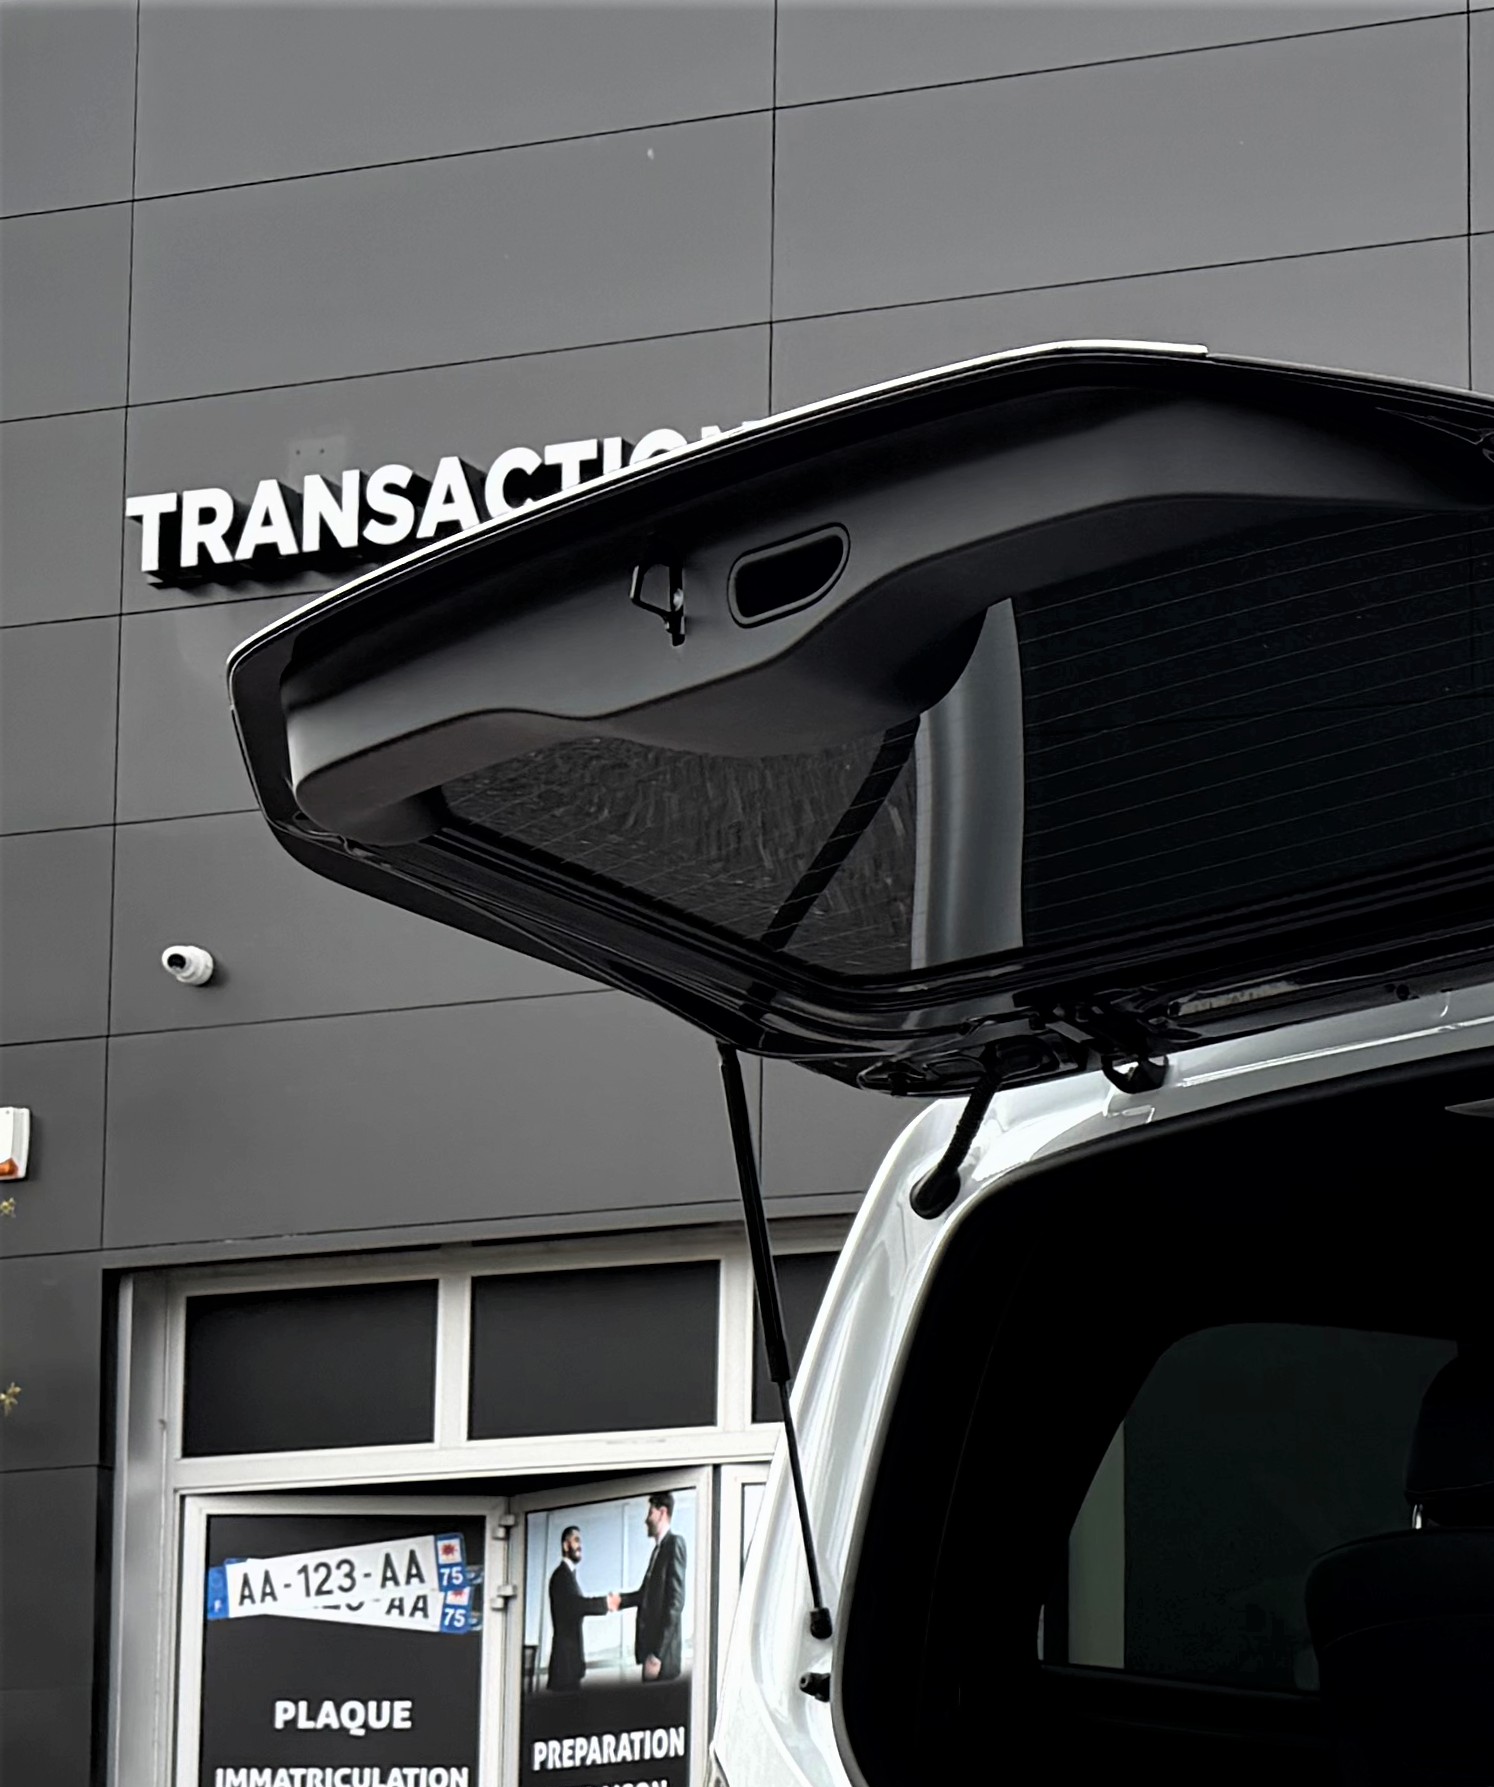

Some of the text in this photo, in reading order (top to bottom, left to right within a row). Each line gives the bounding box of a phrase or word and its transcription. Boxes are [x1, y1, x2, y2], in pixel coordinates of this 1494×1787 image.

[125, 420, 765, 573] TRANSACT
[238, 1548, 427, 1607] AA-123-AA
[440, 1566, 464, 1586] 75
[443, 1607, 466, 1628] 75
[274, 1700, 412, 1737] PLAQUE
[532, 1727, 685, 1771] PREPARATION
